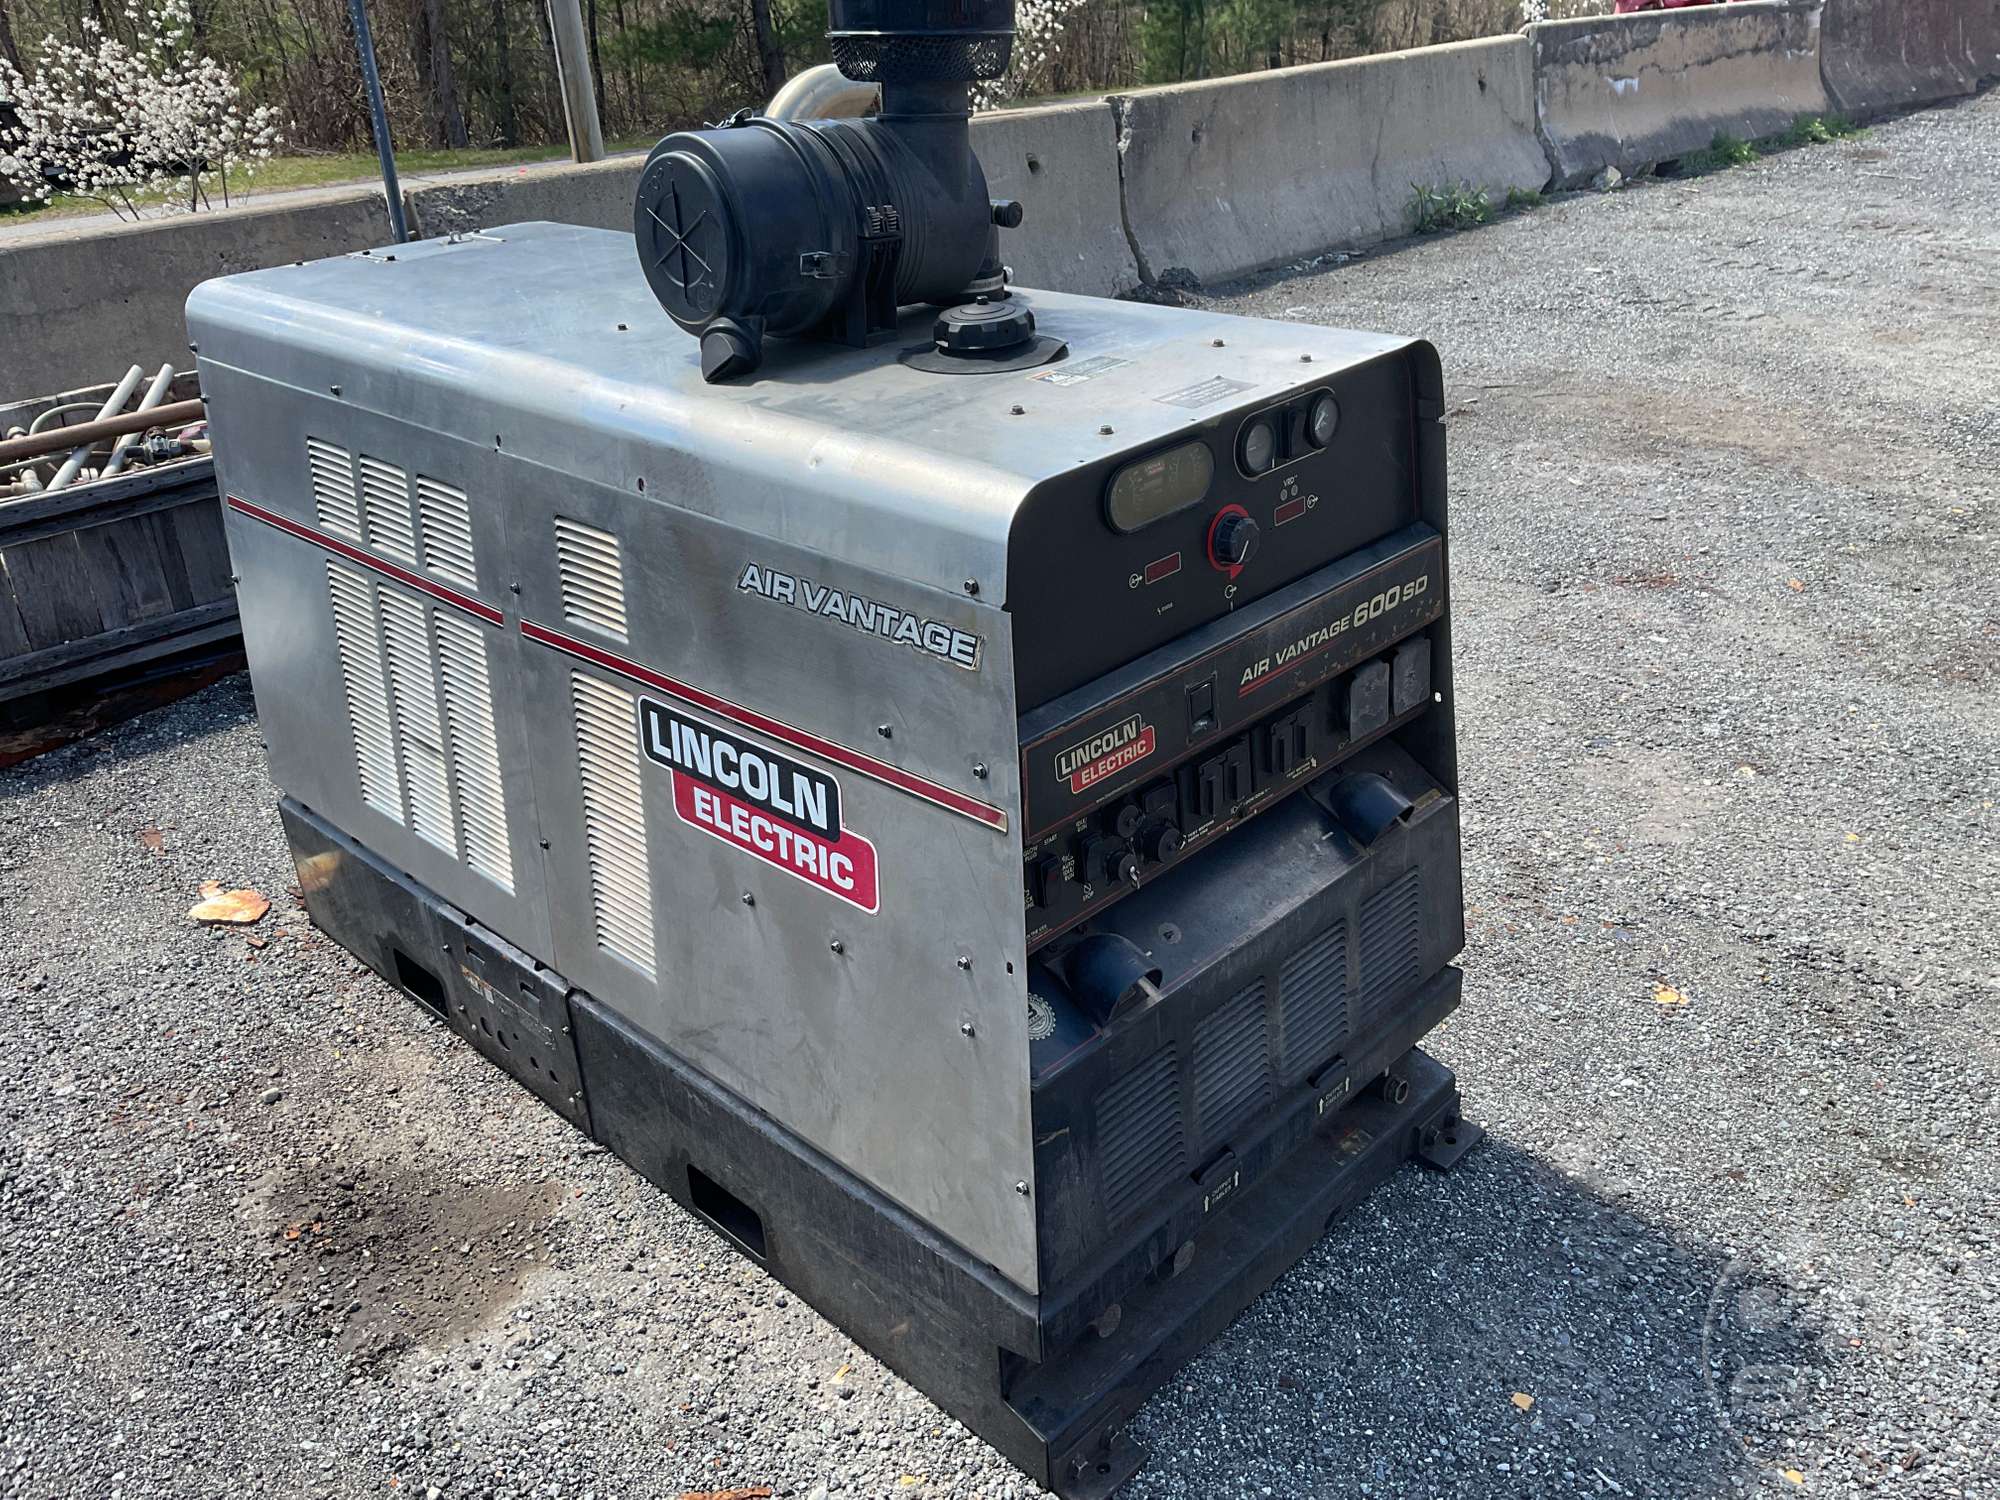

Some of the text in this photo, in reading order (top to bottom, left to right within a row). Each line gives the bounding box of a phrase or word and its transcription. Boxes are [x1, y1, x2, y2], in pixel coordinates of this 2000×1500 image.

[738, 562, 978, 665] AIR VANTAGE
[1240, 574, 1428, 686] AIR VANTAGE 600 SD
[648, 710, 828, 830] LINCOLN
[1060, 719, 1138, 776] LINCOLN
[1080, 740, 1147, 787] ELECTRIC
[692, 785, 856, 891] ELECTRIC
